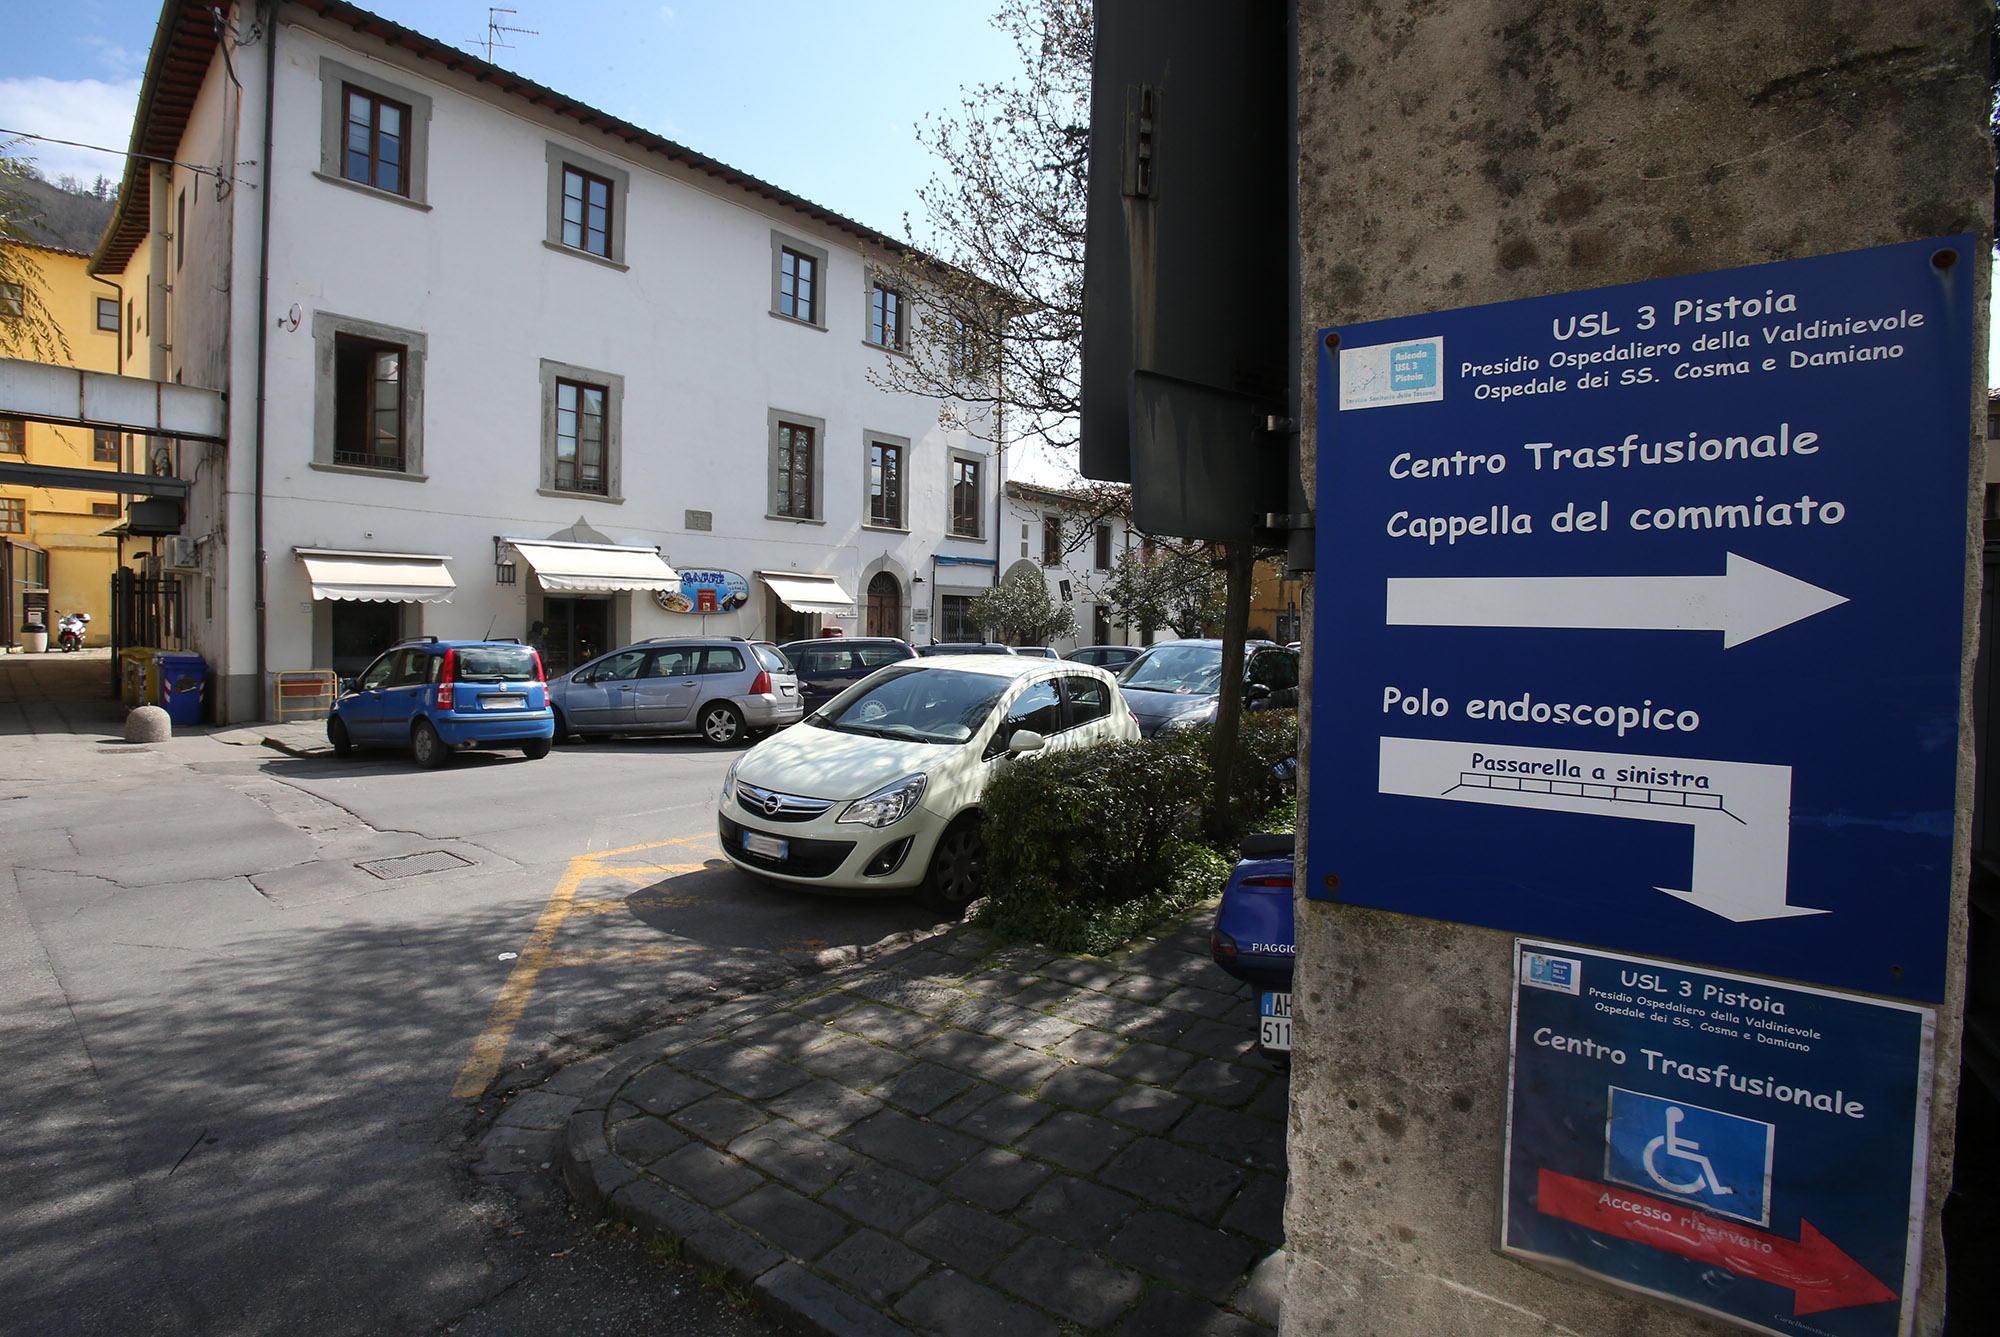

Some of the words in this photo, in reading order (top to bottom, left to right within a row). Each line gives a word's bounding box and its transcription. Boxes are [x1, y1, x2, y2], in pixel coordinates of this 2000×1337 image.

[1554, 311, 1620, 340] USL
[1637, 306, 1655, 329] 3
[1674, 290, 1796, 325] Pistoia
[1395, 363, 1410, 372] USL
[1412, 362, 1418, 370] 3
[1462, 356, 1539, 377] Presidio
[1550, 342, 1680, 369] Ospedaliero
[1692, 331, 1750, 351] della
[1763, 310, 1924, 344] Valdinievole
[1475, 377, 1566, 402] Ospedale
[1577, 371, 1608, 389] dei
[1620, 368, 1659, 385] SS.
[1675, 362, 1749, 379] Cosma
[1762, 359, 1776, 370] e
[1791, 345, 1903, 368] Damiano
[1390, 451, 1505, 479] Centro
[1524, 423, 1819, 470] Trasfusionale
[1387, 505, 1532, 545] Cappella
[1552, 501, 1608, 532] del
[1630, 496, 1845, 530] commiato
[1384, 687, 1448, 716] Polo
[1467, 693, 1699, 737] endoscopico
[1471, 753, 1580, 778] Passarella
[1592, 768, 1605, 780] a
[1616, 766, 1708, 789] sinistra
[1589, 987, 1632, 1002] Presidio
[1636, 997, 1705, 1017] Ospedaliero
[1711, 1011, 1739, 1023] della
[1745, 1018, 1821, 1040] Valdinievole
[1622, 971, 1667, 992] USL
[1679, 981, 1691, 996] 3
[1704, 984, 1785, 1015] Pistoia
[1595, 1003, 1645, 1018] Ospedale
[1650, 1013, 1667, 1023] dei
[1673, 1017, 1693, 1028] SS.
[1700, 1023, 1737, 1037] Cosma
[1758, 1033, 1810, 1052] Damiano
[1534, 1028, 1626, 1064] Centro
[1640, 1049, 1864, 1119] Trasfusionale
[1599, 1192, 1672, 1222] Accesso
[1680, 1217, 1772, 1253] riservato
